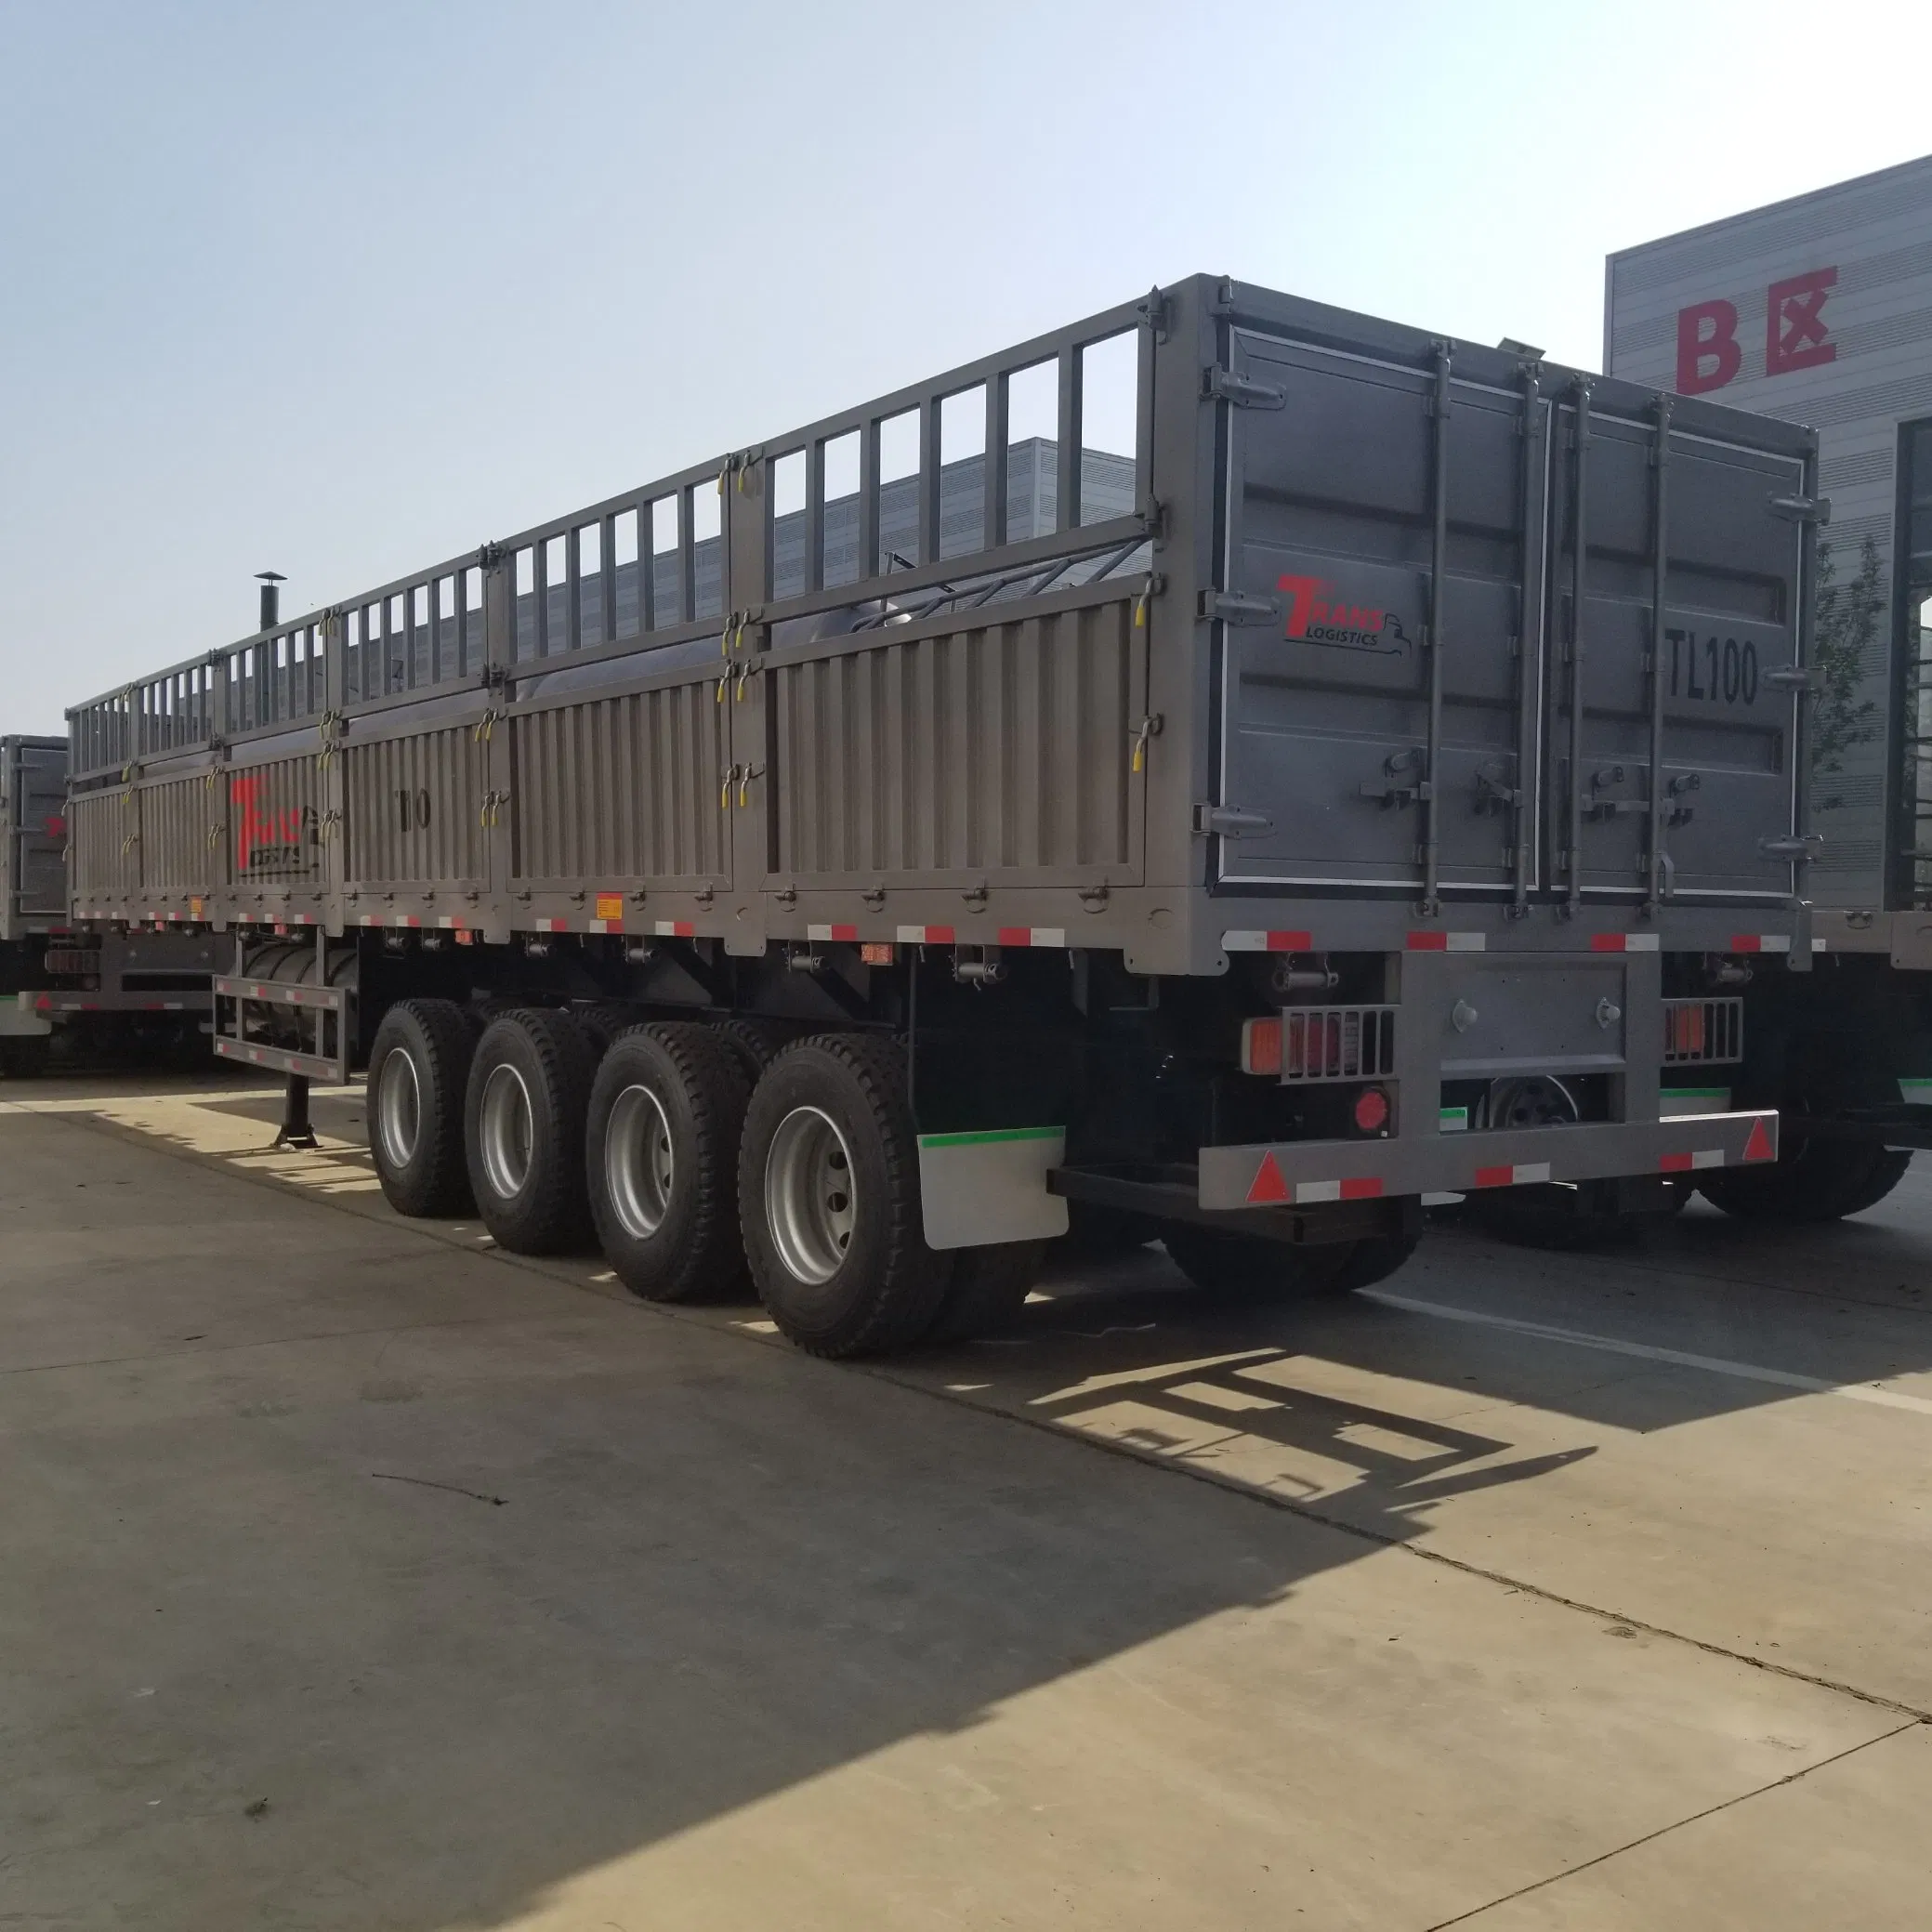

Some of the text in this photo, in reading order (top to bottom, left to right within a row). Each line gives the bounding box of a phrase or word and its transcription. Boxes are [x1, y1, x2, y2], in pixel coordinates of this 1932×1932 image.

[1277, 573, 1384, 637] TRANS
[1307, 625, 1378, 647] LOGISTICS
[1665, 628, 1757, 705] TL100
